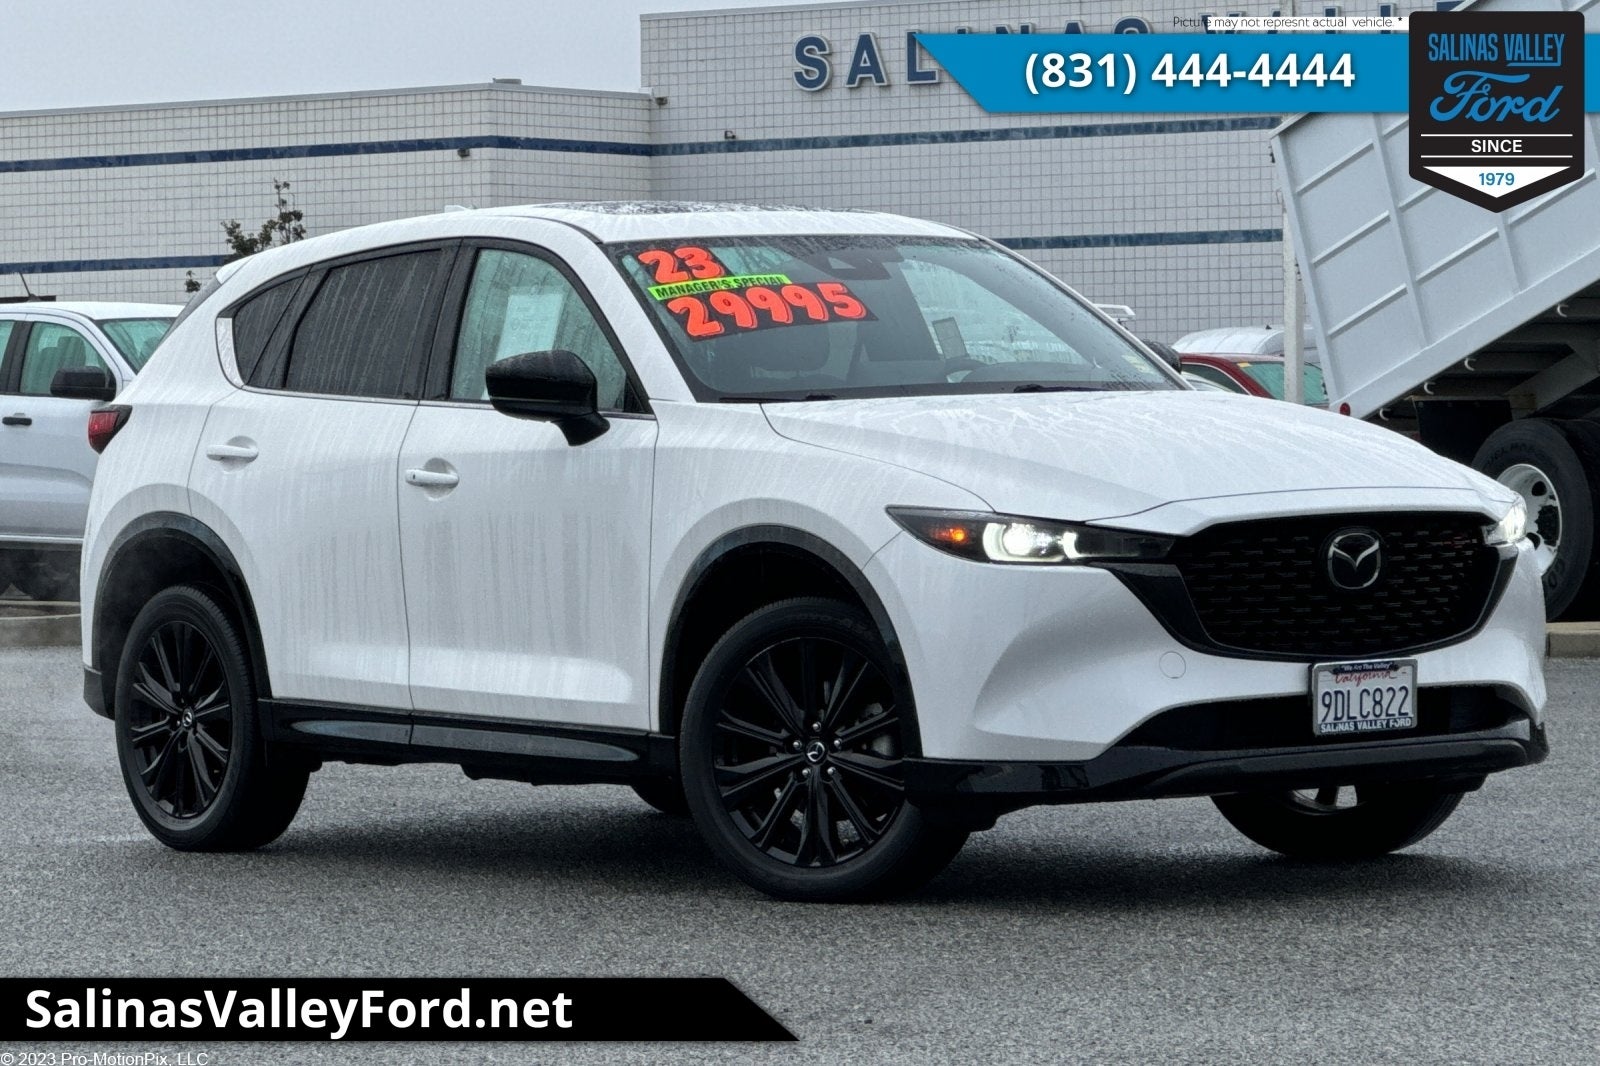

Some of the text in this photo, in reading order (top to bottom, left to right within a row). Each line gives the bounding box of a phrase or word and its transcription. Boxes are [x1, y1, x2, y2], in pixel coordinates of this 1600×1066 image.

[638, 246, 724, 284] 23
[655, 276, 785, 298] MANAGER'S SPECIAL
[667, 282, 867, 337] 29995
[1321, 685, 1409, 722] 9DLC822
[1321, 717, 1412, 733] SALINAS VALLEY FORD
